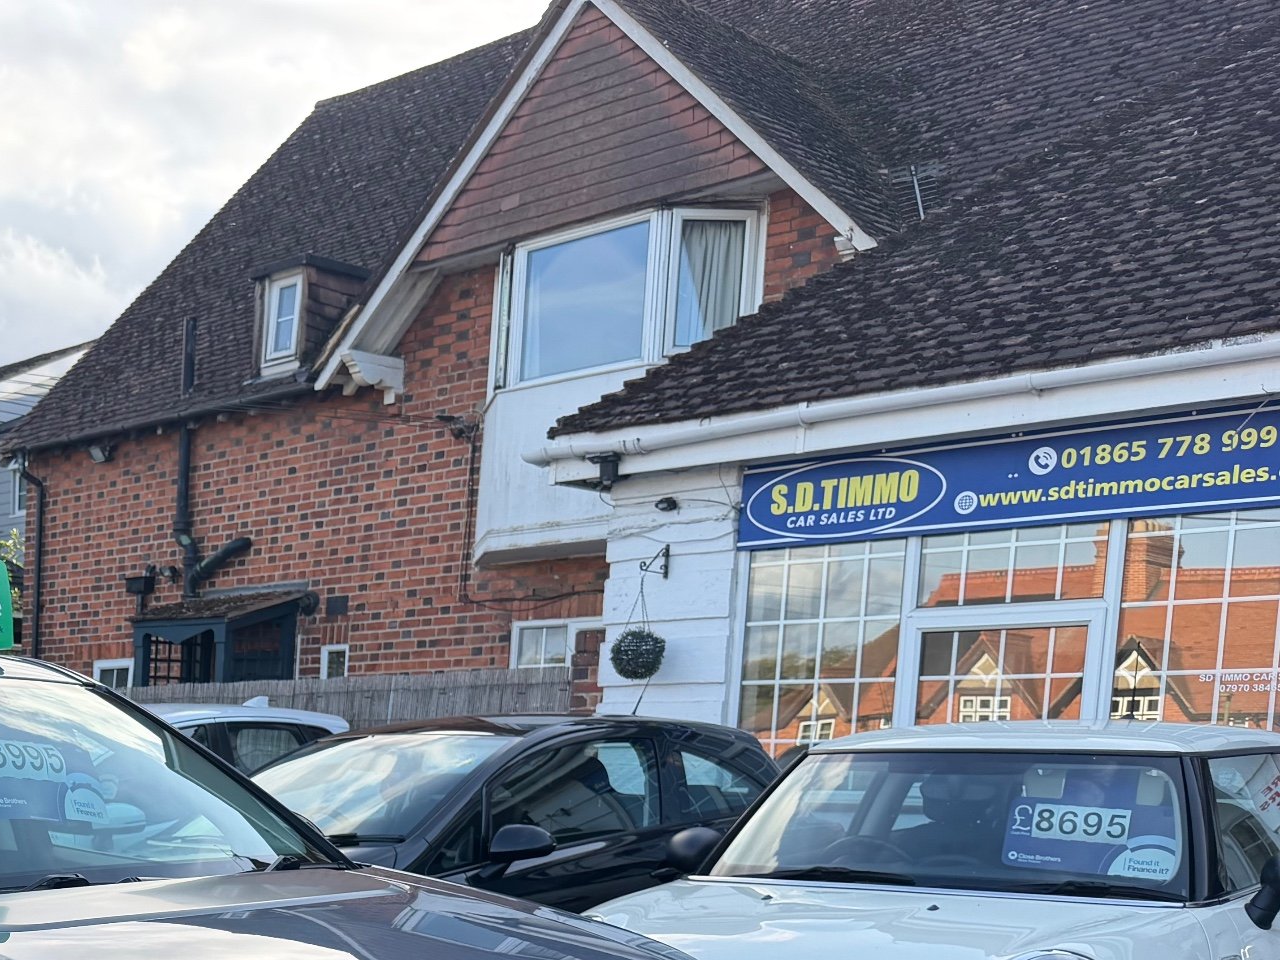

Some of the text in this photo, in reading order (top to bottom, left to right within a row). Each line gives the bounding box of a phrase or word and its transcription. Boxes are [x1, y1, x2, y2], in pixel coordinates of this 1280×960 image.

[1061, 425, 1278, 469] 01865 778 999
[770, 469, 920, 516] S.D.TIMMO
[978, 464, 1280, 507] www.sdtimmocarsales.
[786, 507, 896, 529] CAR SALES LTD
[1199, 673, 1274, 682] SD IMMO CAR
[1219, 684, 1250, 692] 07970
[1127, 864, 1158, 874] Finance
[1128, 857, 1153, 867] Found
